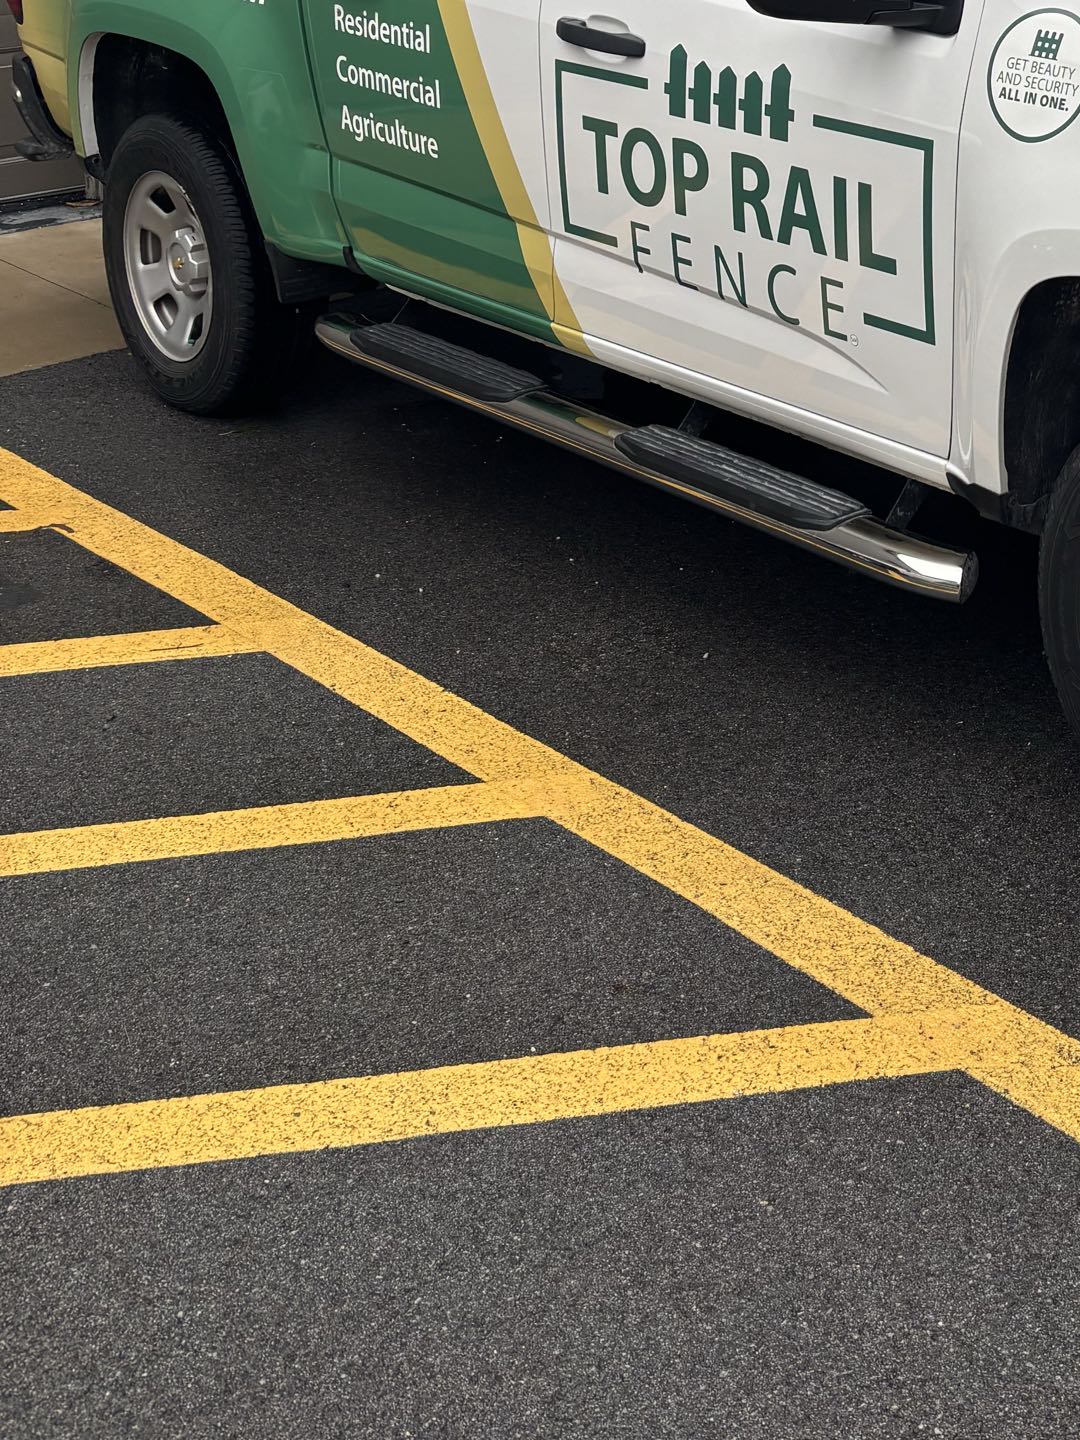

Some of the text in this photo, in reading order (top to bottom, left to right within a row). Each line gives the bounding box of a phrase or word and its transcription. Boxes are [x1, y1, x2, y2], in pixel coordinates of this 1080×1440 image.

[333, 4, 431, 54] Residential
[336, 56, 441, 109] Commercial
[996, 70, 1079, 97] AND SECURITY
[1006, 56, 1076, 80] GET BEAUTY
[998, 87, 1069, 112] ALL IN ONE.
[341, 104, 439, 159] Agriculture
[582, 115, 897, 276] TOP RAIL
[630, 220, 848, 342] FENCE
